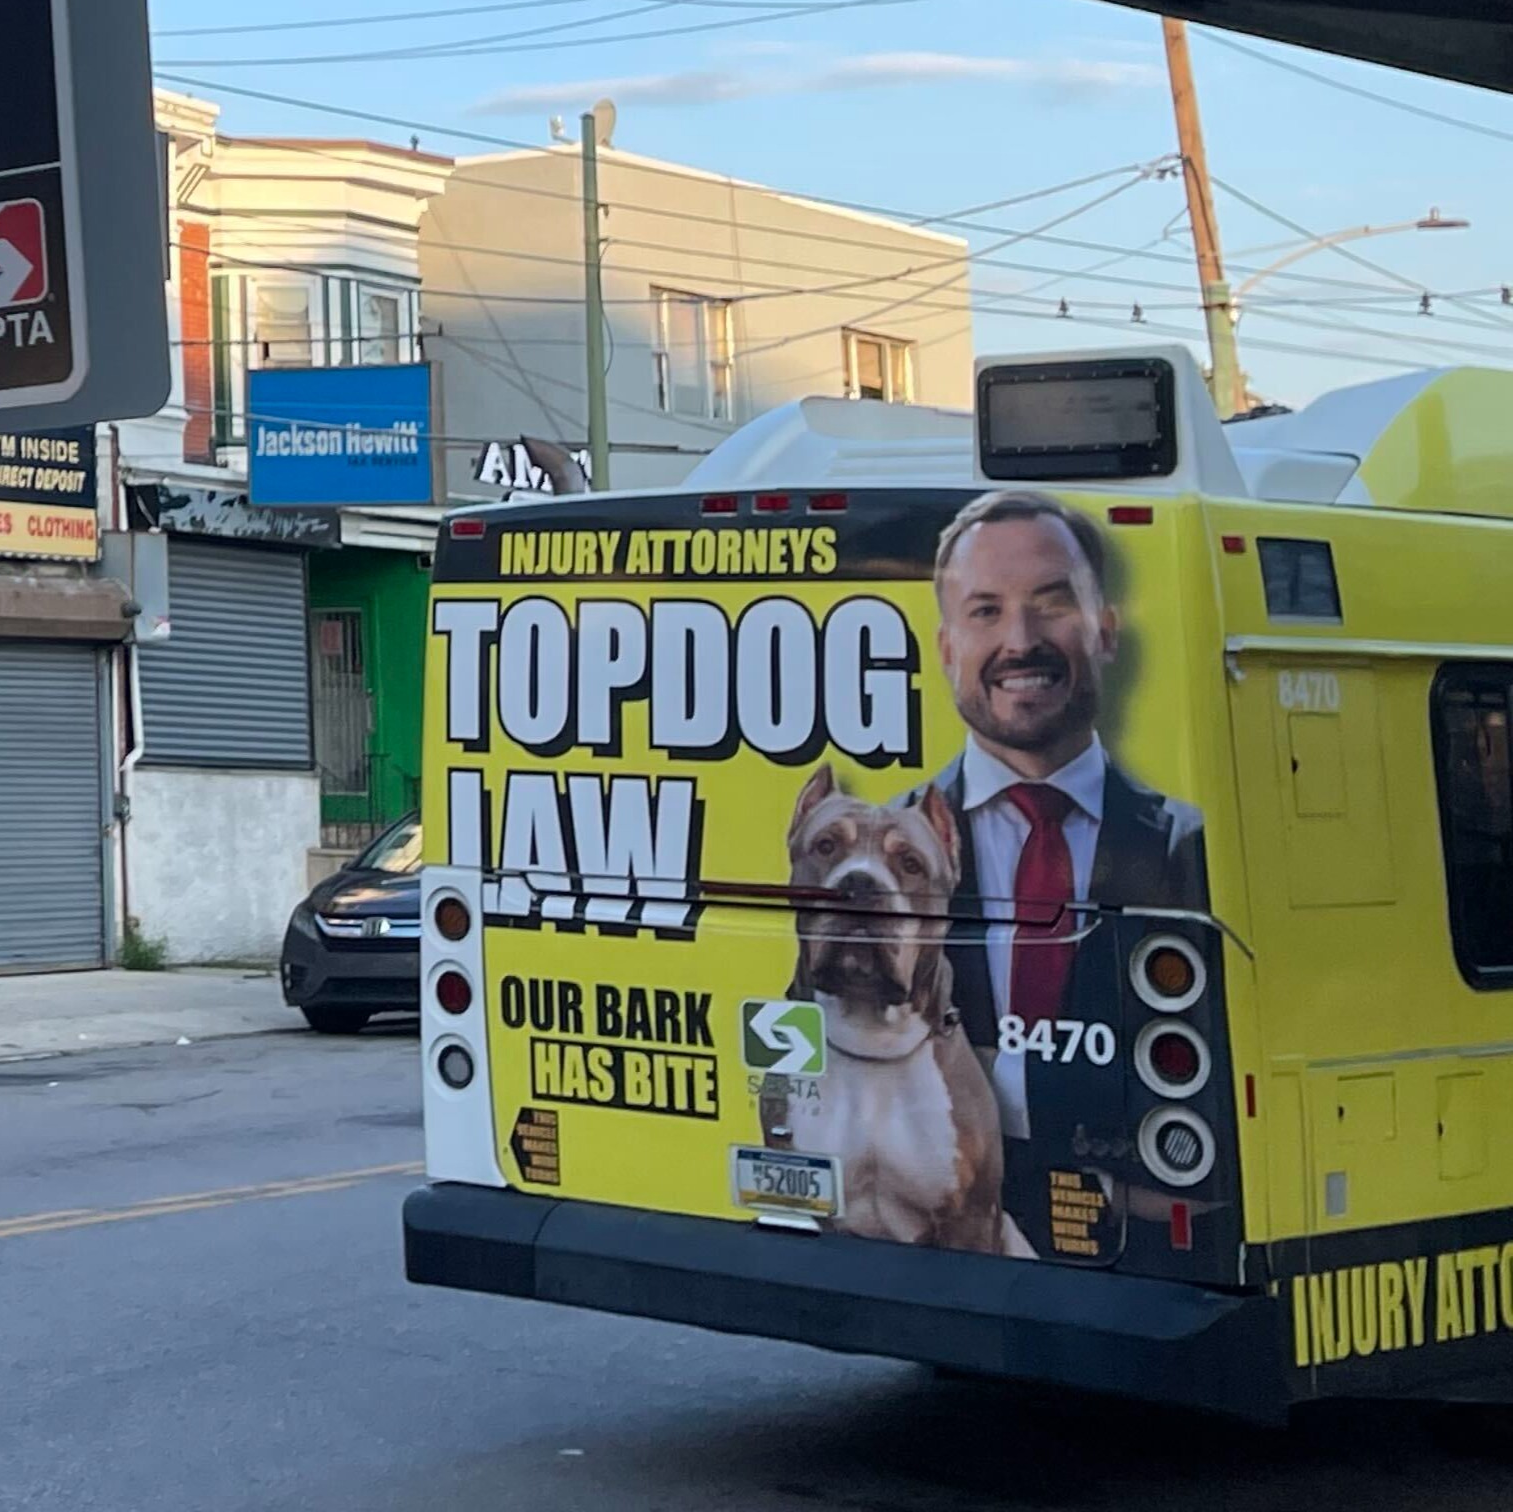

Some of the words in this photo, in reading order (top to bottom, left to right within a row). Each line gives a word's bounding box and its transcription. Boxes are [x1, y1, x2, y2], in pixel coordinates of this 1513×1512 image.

[21, 437, 80, 464] INSIDE
[256, 424, 342, 456] Jackson
[346, 421, 418, 455] Hewitt
[36, 468, 86, 493] DEPOSIT
[27, 515, 95, 541] CLOTHING
[500, 531, 620, 575] INJURY
[626, 527, 837, 575] ATTORNEYS
[433, 595, 923, 769] TOPDOG
[1278, 670, 1340, 712] 8470
[500, 975, 584, 1035] OUR
[595, 985, 714, 1048] BARK
[998, 1014, 1116, 1066] 8470
[535, 1041, 616, 1103] HAS
[624, 1051, 717, 1114] BITE
[763, 1164, 820, 1199] 52005
[1293, 1256, 1428, 1367] INJURY
